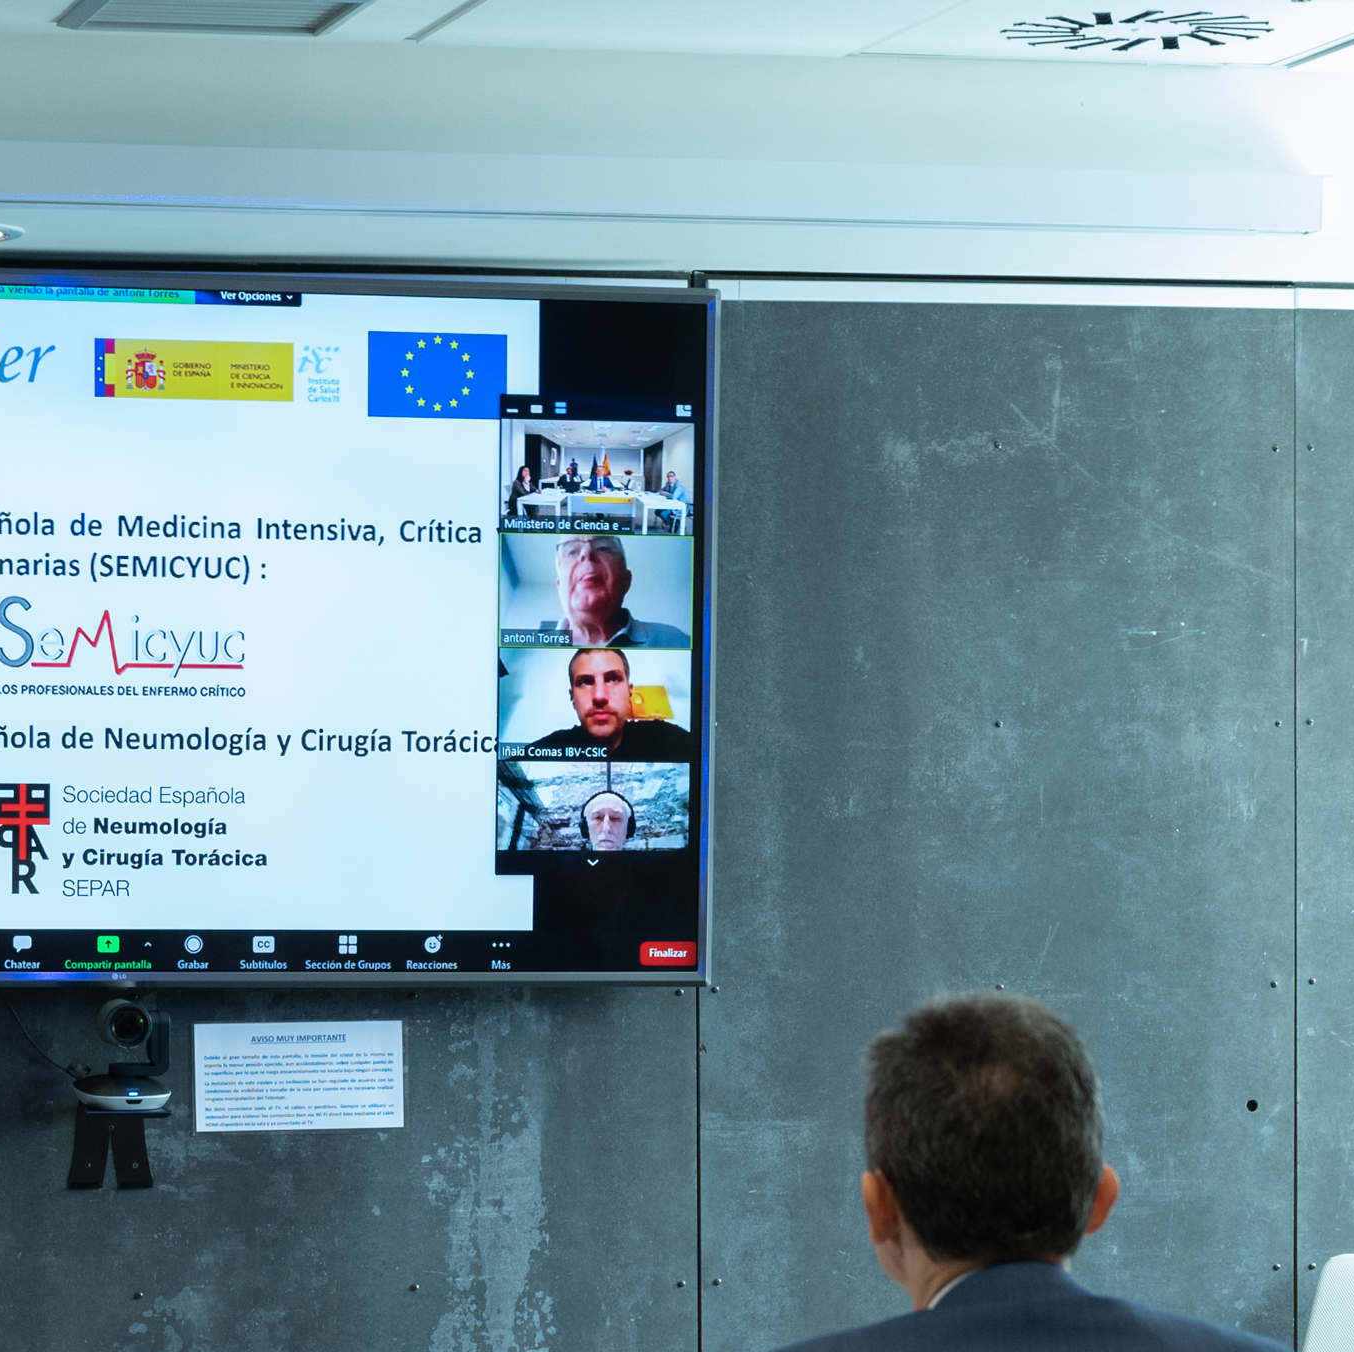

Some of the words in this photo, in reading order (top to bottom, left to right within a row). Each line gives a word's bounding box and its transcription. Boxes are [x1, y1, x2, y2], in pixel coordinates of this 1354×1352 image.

[8, 285, 43, 294] viendo
[56, 287, 95, 298] pantalla
[97, 288, 109, 296] de
[220, 291, 237, 300] Ver
[238, 292, 281, 302] Opciones
[173, 362, 211, 370] GOBIERNO
[231, 364, 271, 372] MINISTERIO
[184, 370, 211, 378] ESPAÑA
[308, 377, 339, 386] Instituto
[308, 386, 317, 394] de
[320, 386, 339, 394] Salud
[308, 394, 331, 402] Carlos
[70, 513, 103, 538] de
[117, 516, 243, 540] Medicina
[256, 517, 385, 546] Intensiva,
[399, 518, 483, 544] Crítica
[505, 519, 555, 530] Ministerio
[558, 519, 571, 530] de
[574, 520, 609, 531] Ciencia
[612, 522, 619, 530] e
[90, 552, 251, 584] (SEMICYUC)
[503, 633, 535, 644] antoni
[538, 634, 569, 644] Torres
[21, 684, 115, 696] PROFESIONALES
[118, 686, 139, 696] DEL
[142, 686, 197, 698] ENFERMO
[200, 685, 247, 698] CRÍTICO
[61, 726, 93, 750] de
[103, 726, 267, 756] Neumología
[278, 735, 291, 756] y
[301, 728, 391, 756] Cirugía
[401, 729, 497, 754] Torácic
[502, 746, 525, 757] Iñaki
[528, 747, 563, 757] Comas
[565, 747, 607, 758] IBV-CSIC
[62, 784, 151, 804] Sociedad
[160, 785, 245, 808] Española
[62, 816, 87, 836] de
[94, 817, 227, 840] Neumología
[62, 853, 75, 868] y
[82, 848, 165, 870] Cirugía
[172, 849, 267, 868] Torácica
[62, 880, 131, 898] SEPAR
[648, 948, 687, 960] Finalizar
[4, 960, 41, 970] Chatear
[64, 960, 113, 970] Compartir
[115, 960, 152, 970] pantalla
[177, 960, 209, 970] Grabar
[239, 959, 287, 970] Subtítulos
[305, 959, 343, 971] Sección
[345, 960, 356, 970] de
[358, 960, 392, 972] Grupos
[406, 960, 459, 971] Reacciones
[491, 959, 511, 971] Más
[296, 1034, 347, 1042] IMPORTANTE
